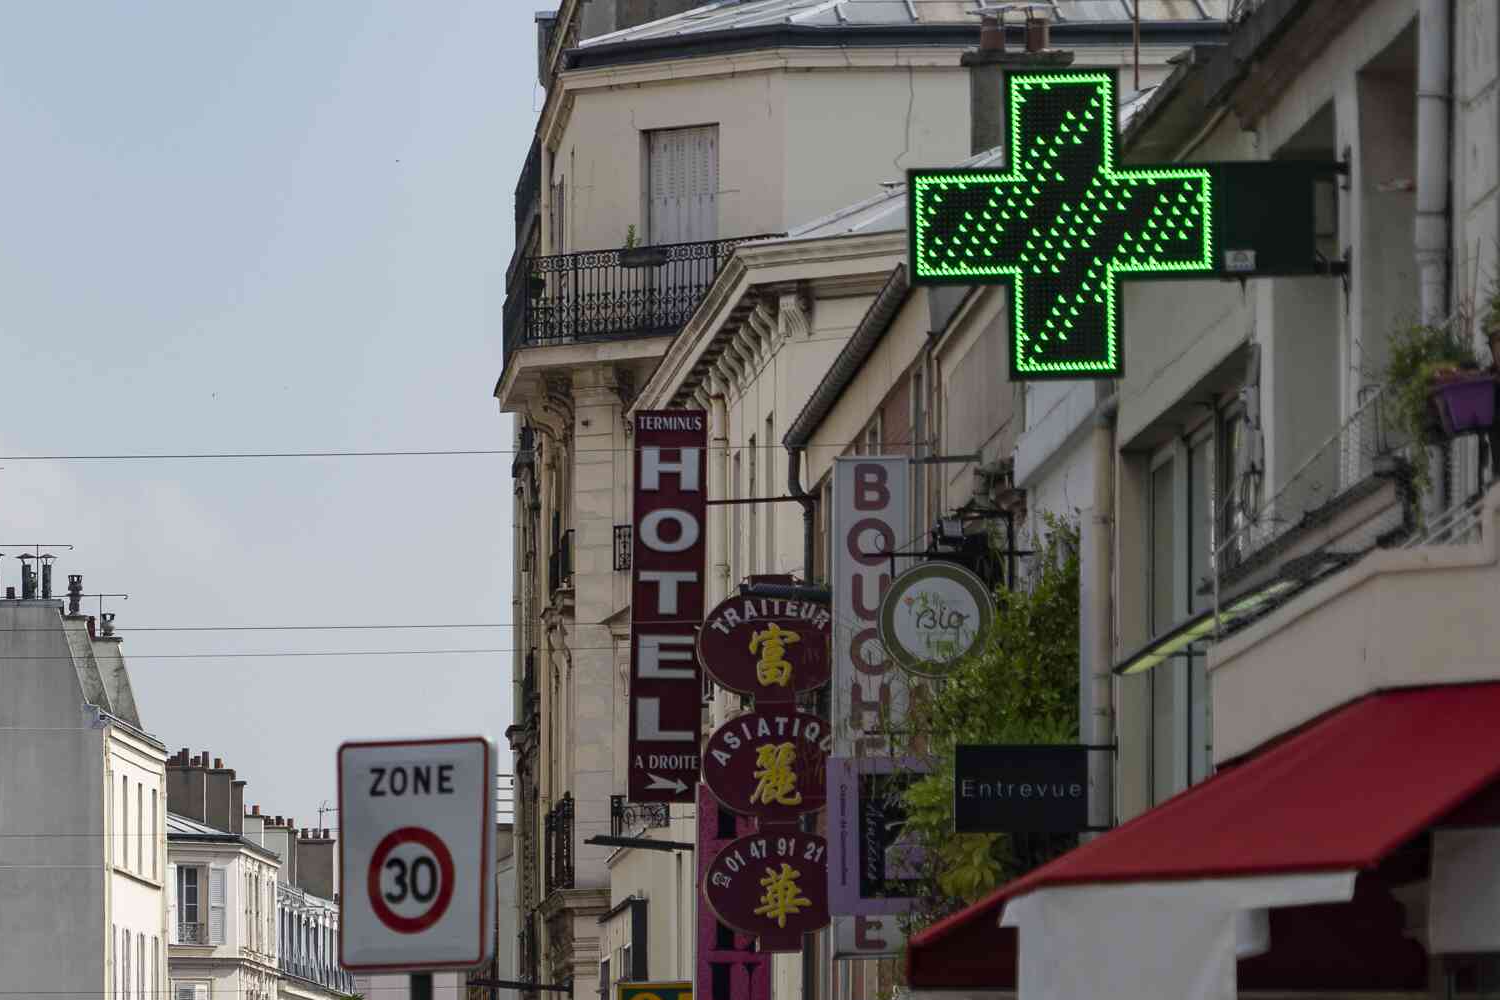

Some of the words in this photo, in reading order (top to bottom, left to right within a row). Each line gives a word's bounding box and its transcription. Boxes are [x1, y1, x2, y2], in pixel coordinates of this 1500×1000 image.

[639, 416, 702, 431] TERMINUS
[636, 446, 700, 742] HOTEL
[711, 599, 831, 637] TRAITEUR
[749, 622, 800, 687] 富
[649, 754, 699, 769] DROITE
[750, 741, 802, 805] 麗
[369, 765, 455, 797] ZONE
[962, 779, 1083, 798] Entrevue
[725, 850, 746, 874] 01
[750, 840, 768, 859] 47
[777, 838, 796, 857] 91
[803, 842, 824, 864] 21
[384, 856, 438, 905] 30
[754, 863, 812, 928] 華
